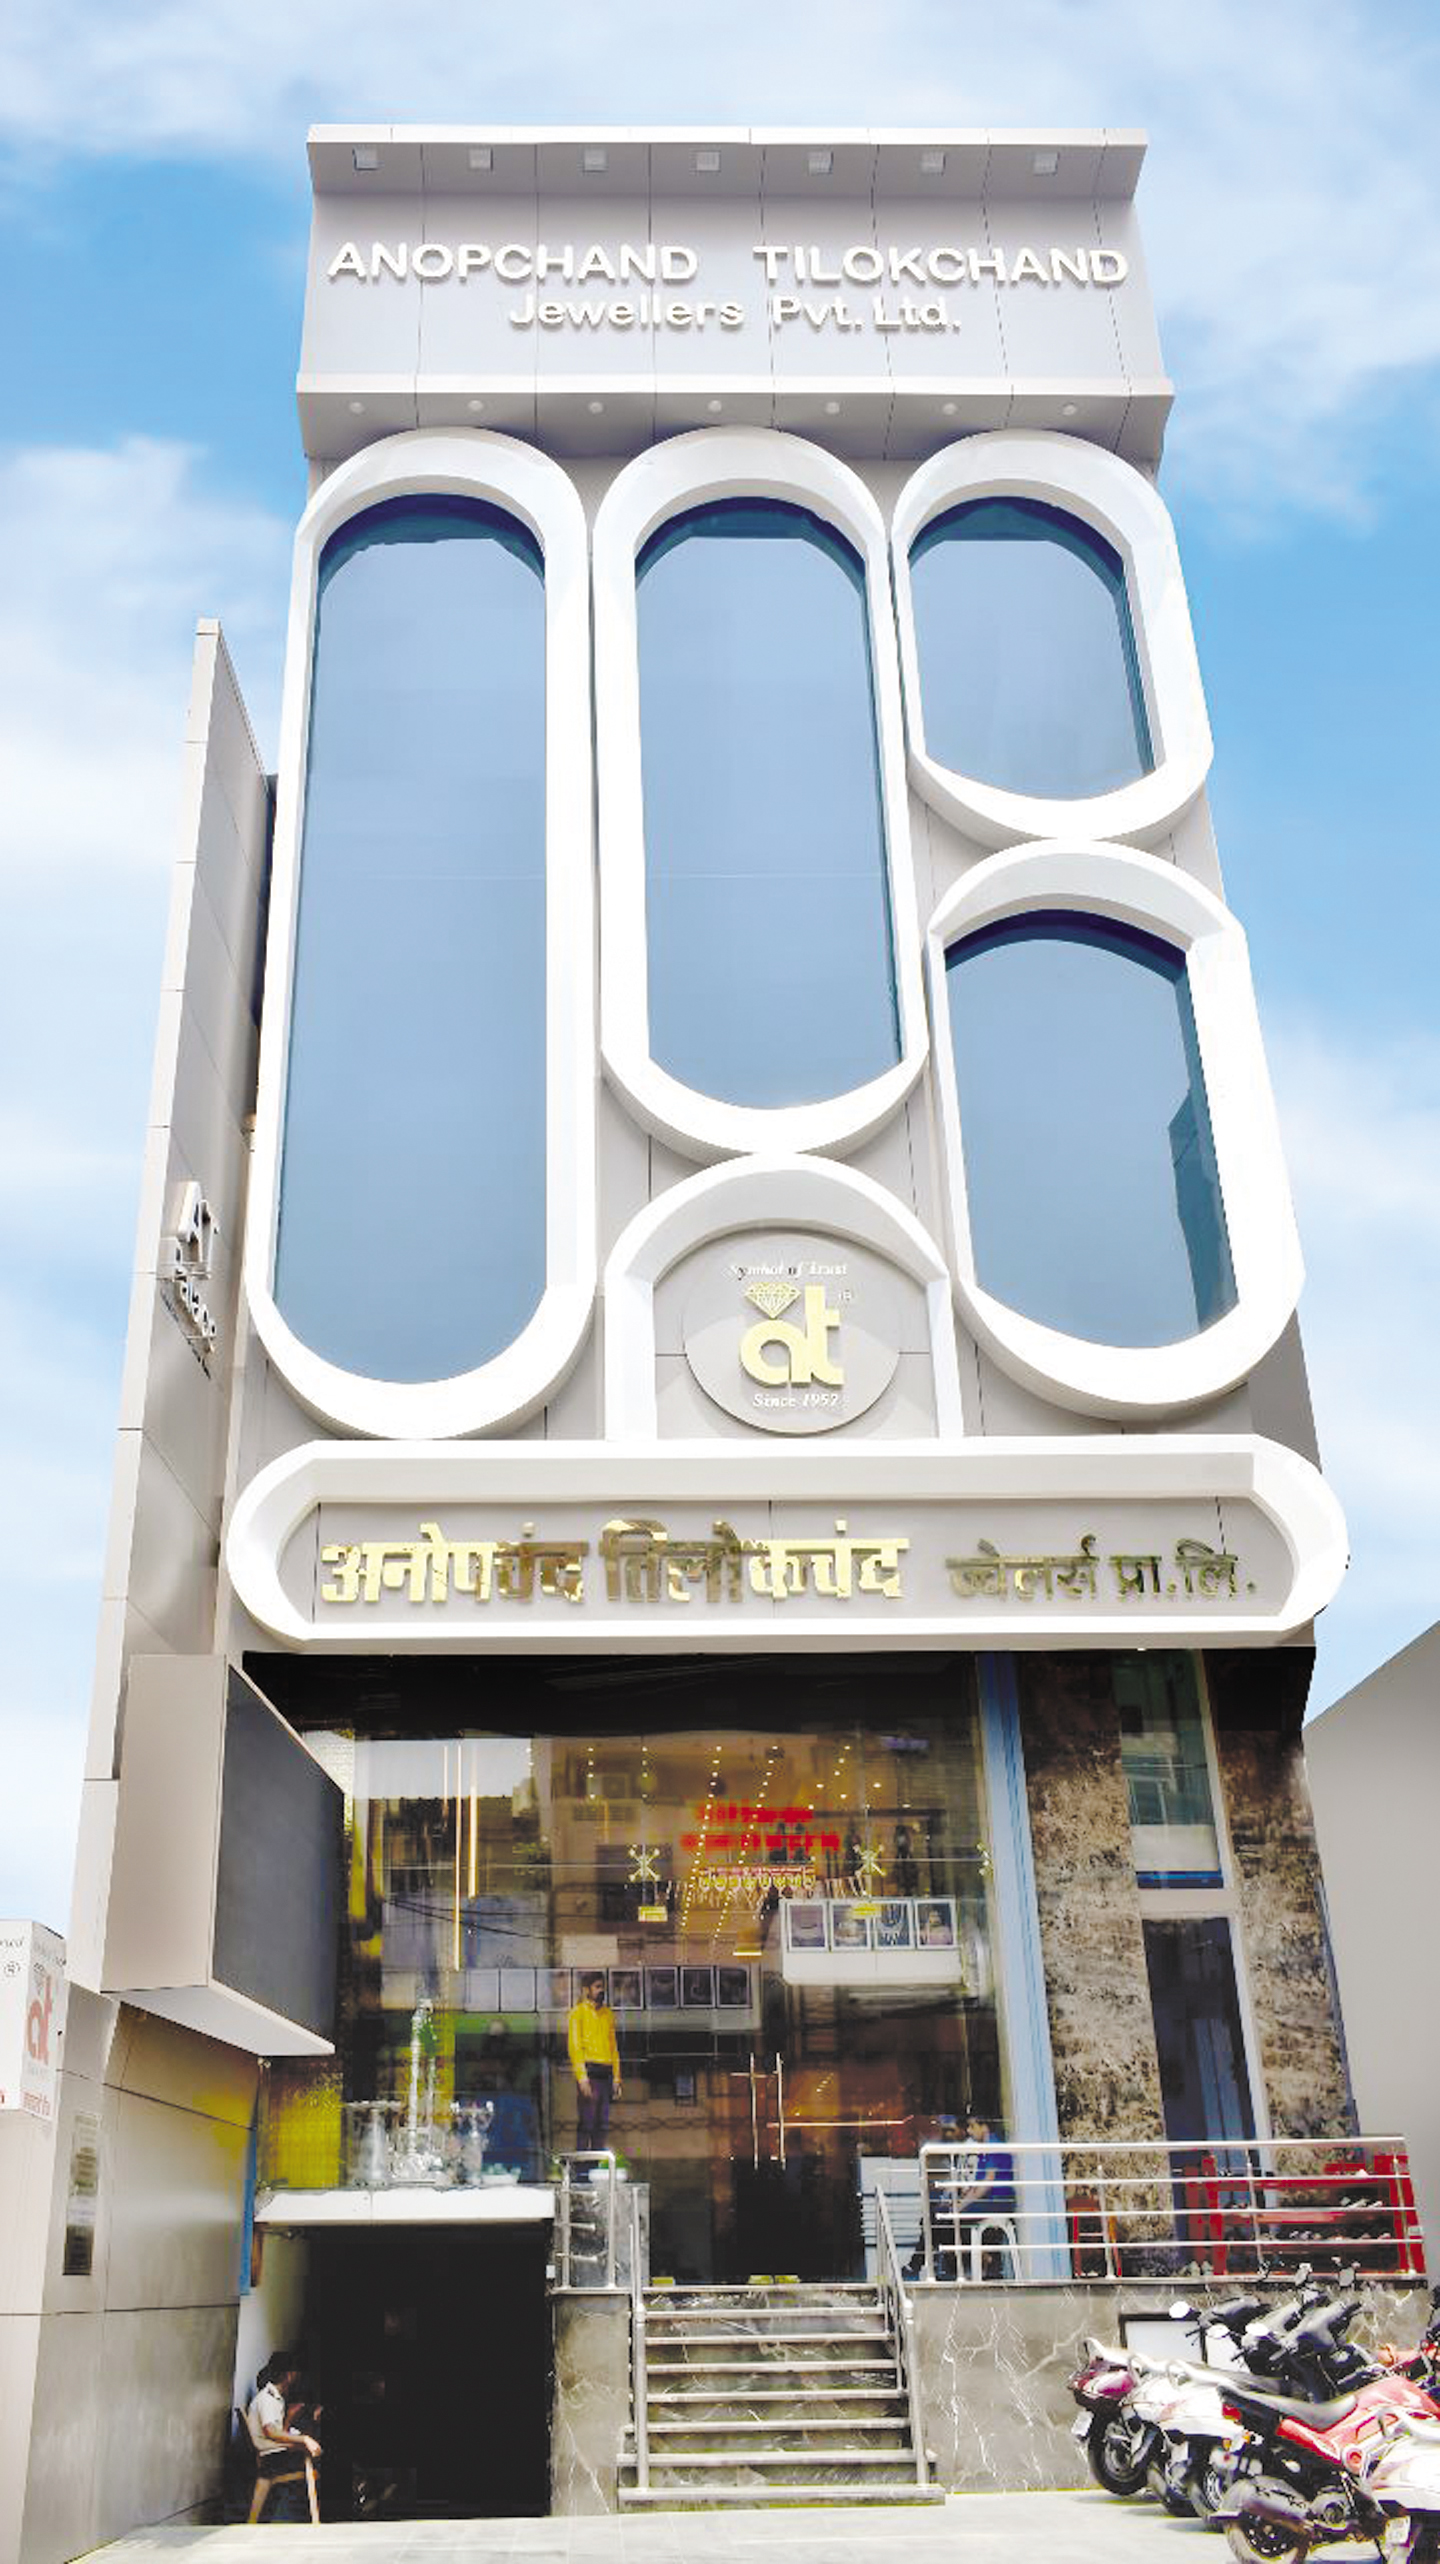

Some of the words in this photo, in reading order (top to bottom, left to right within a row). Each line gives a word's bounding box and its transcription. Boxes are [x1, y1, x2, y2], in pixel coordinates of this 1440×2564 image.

[327, 242, 698, 284] ANOPCHAND
[753, 246, 1130, 287] TILOKCHAND
[510, 294, 744, 329] Jewellers
[773, 297, 864, 328] Pvt.
[874, 297, 962, 331] Ltd.
[740, 1284, 845, 1389] at
[752, 1393, 796, 1409] Since
[321, 1522, 588, 1603] अनोपचंद
[599, 1519, 910, 1603] तिलोकचंद
